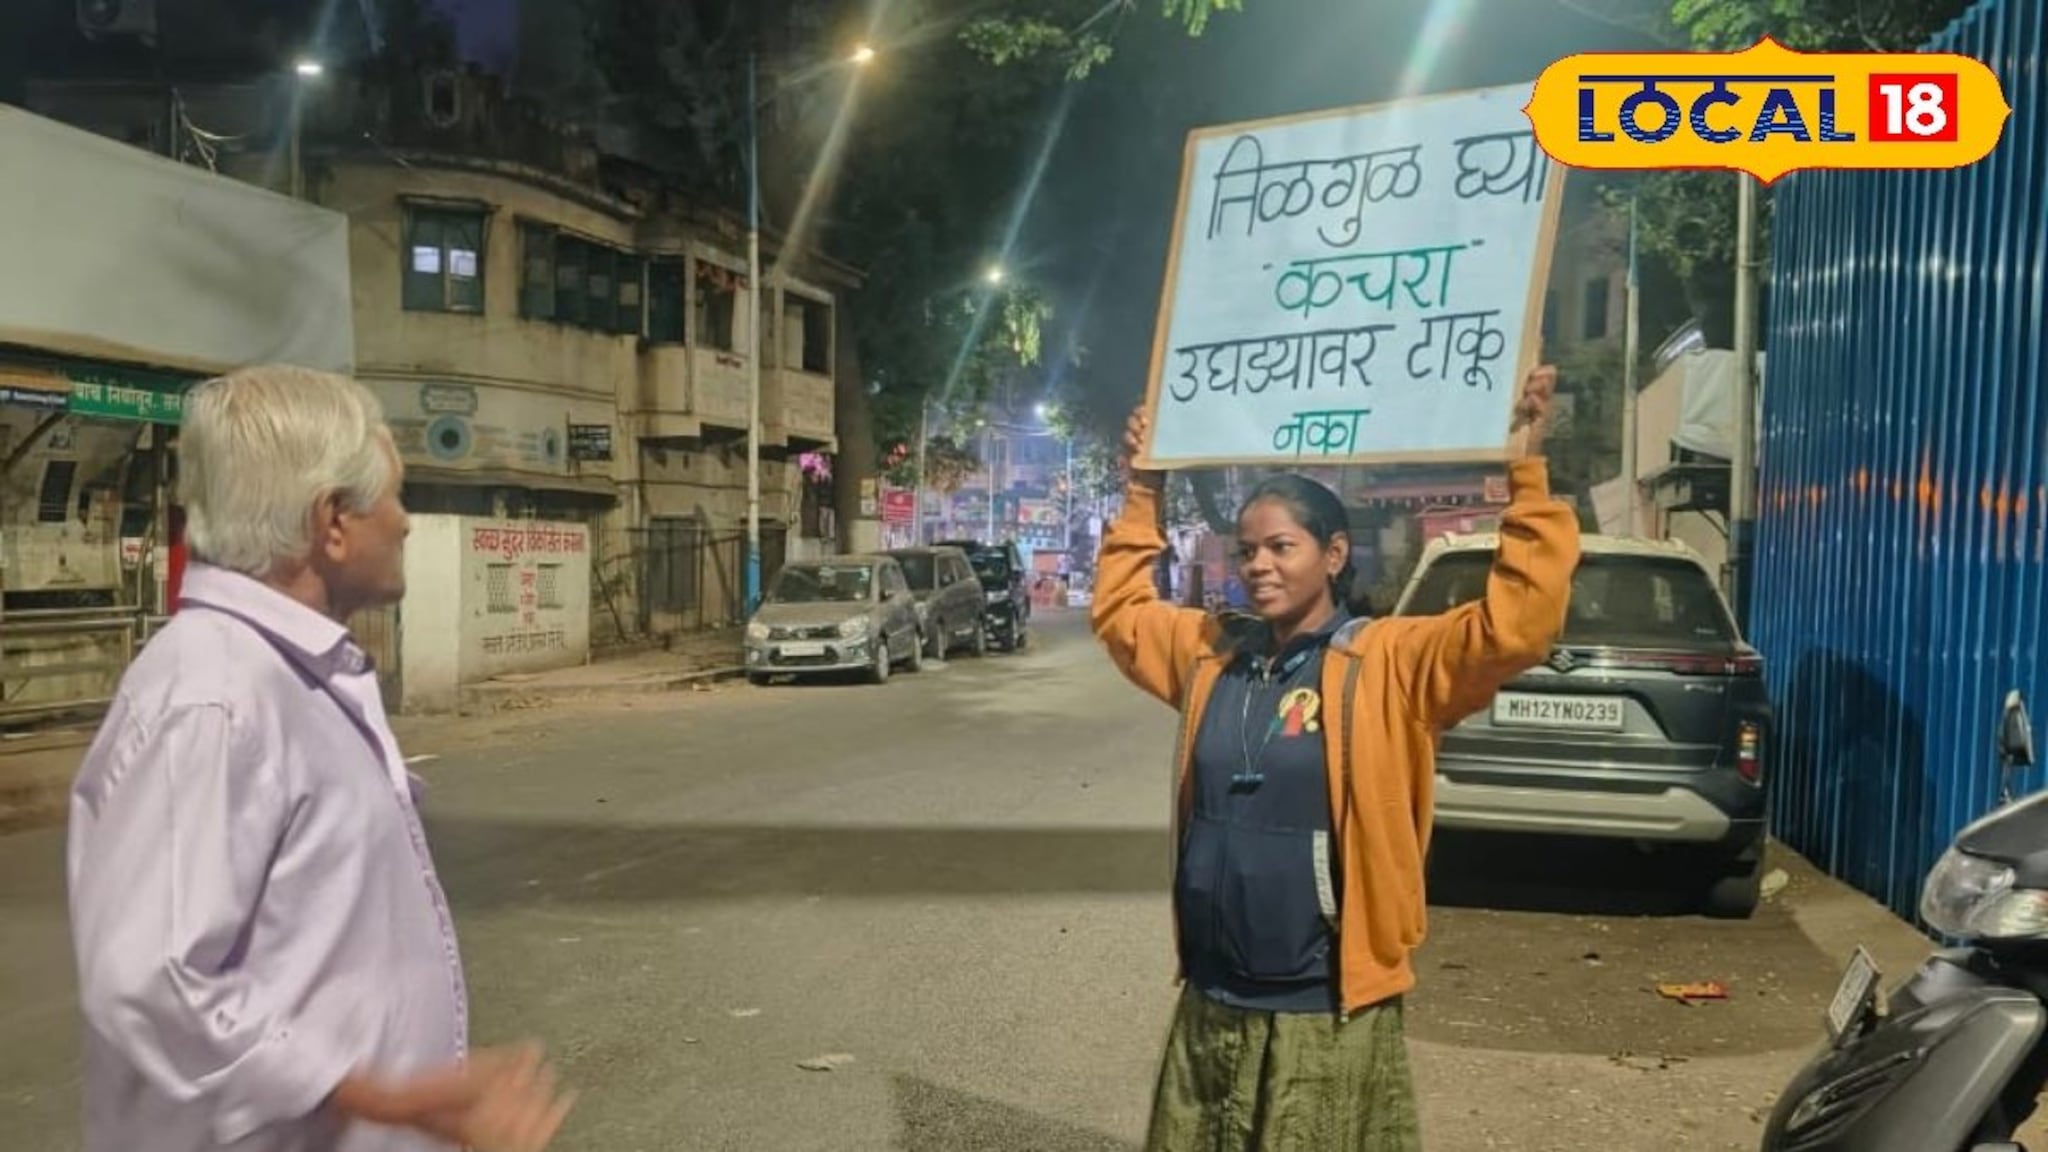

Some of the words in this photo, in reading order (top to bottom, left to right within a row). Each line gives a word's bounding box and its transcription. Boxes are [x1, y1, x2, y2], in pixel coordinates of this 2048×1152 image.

[1207, 134, 1423, 248] तिळगुळ
[1453, 130, 1549, 204] घ्या
[1407, 310, 1505, 391] टाकू
[1273, 408, 1371, 456] नका
[1508, 699, 1618, 721] MH12YN0239
